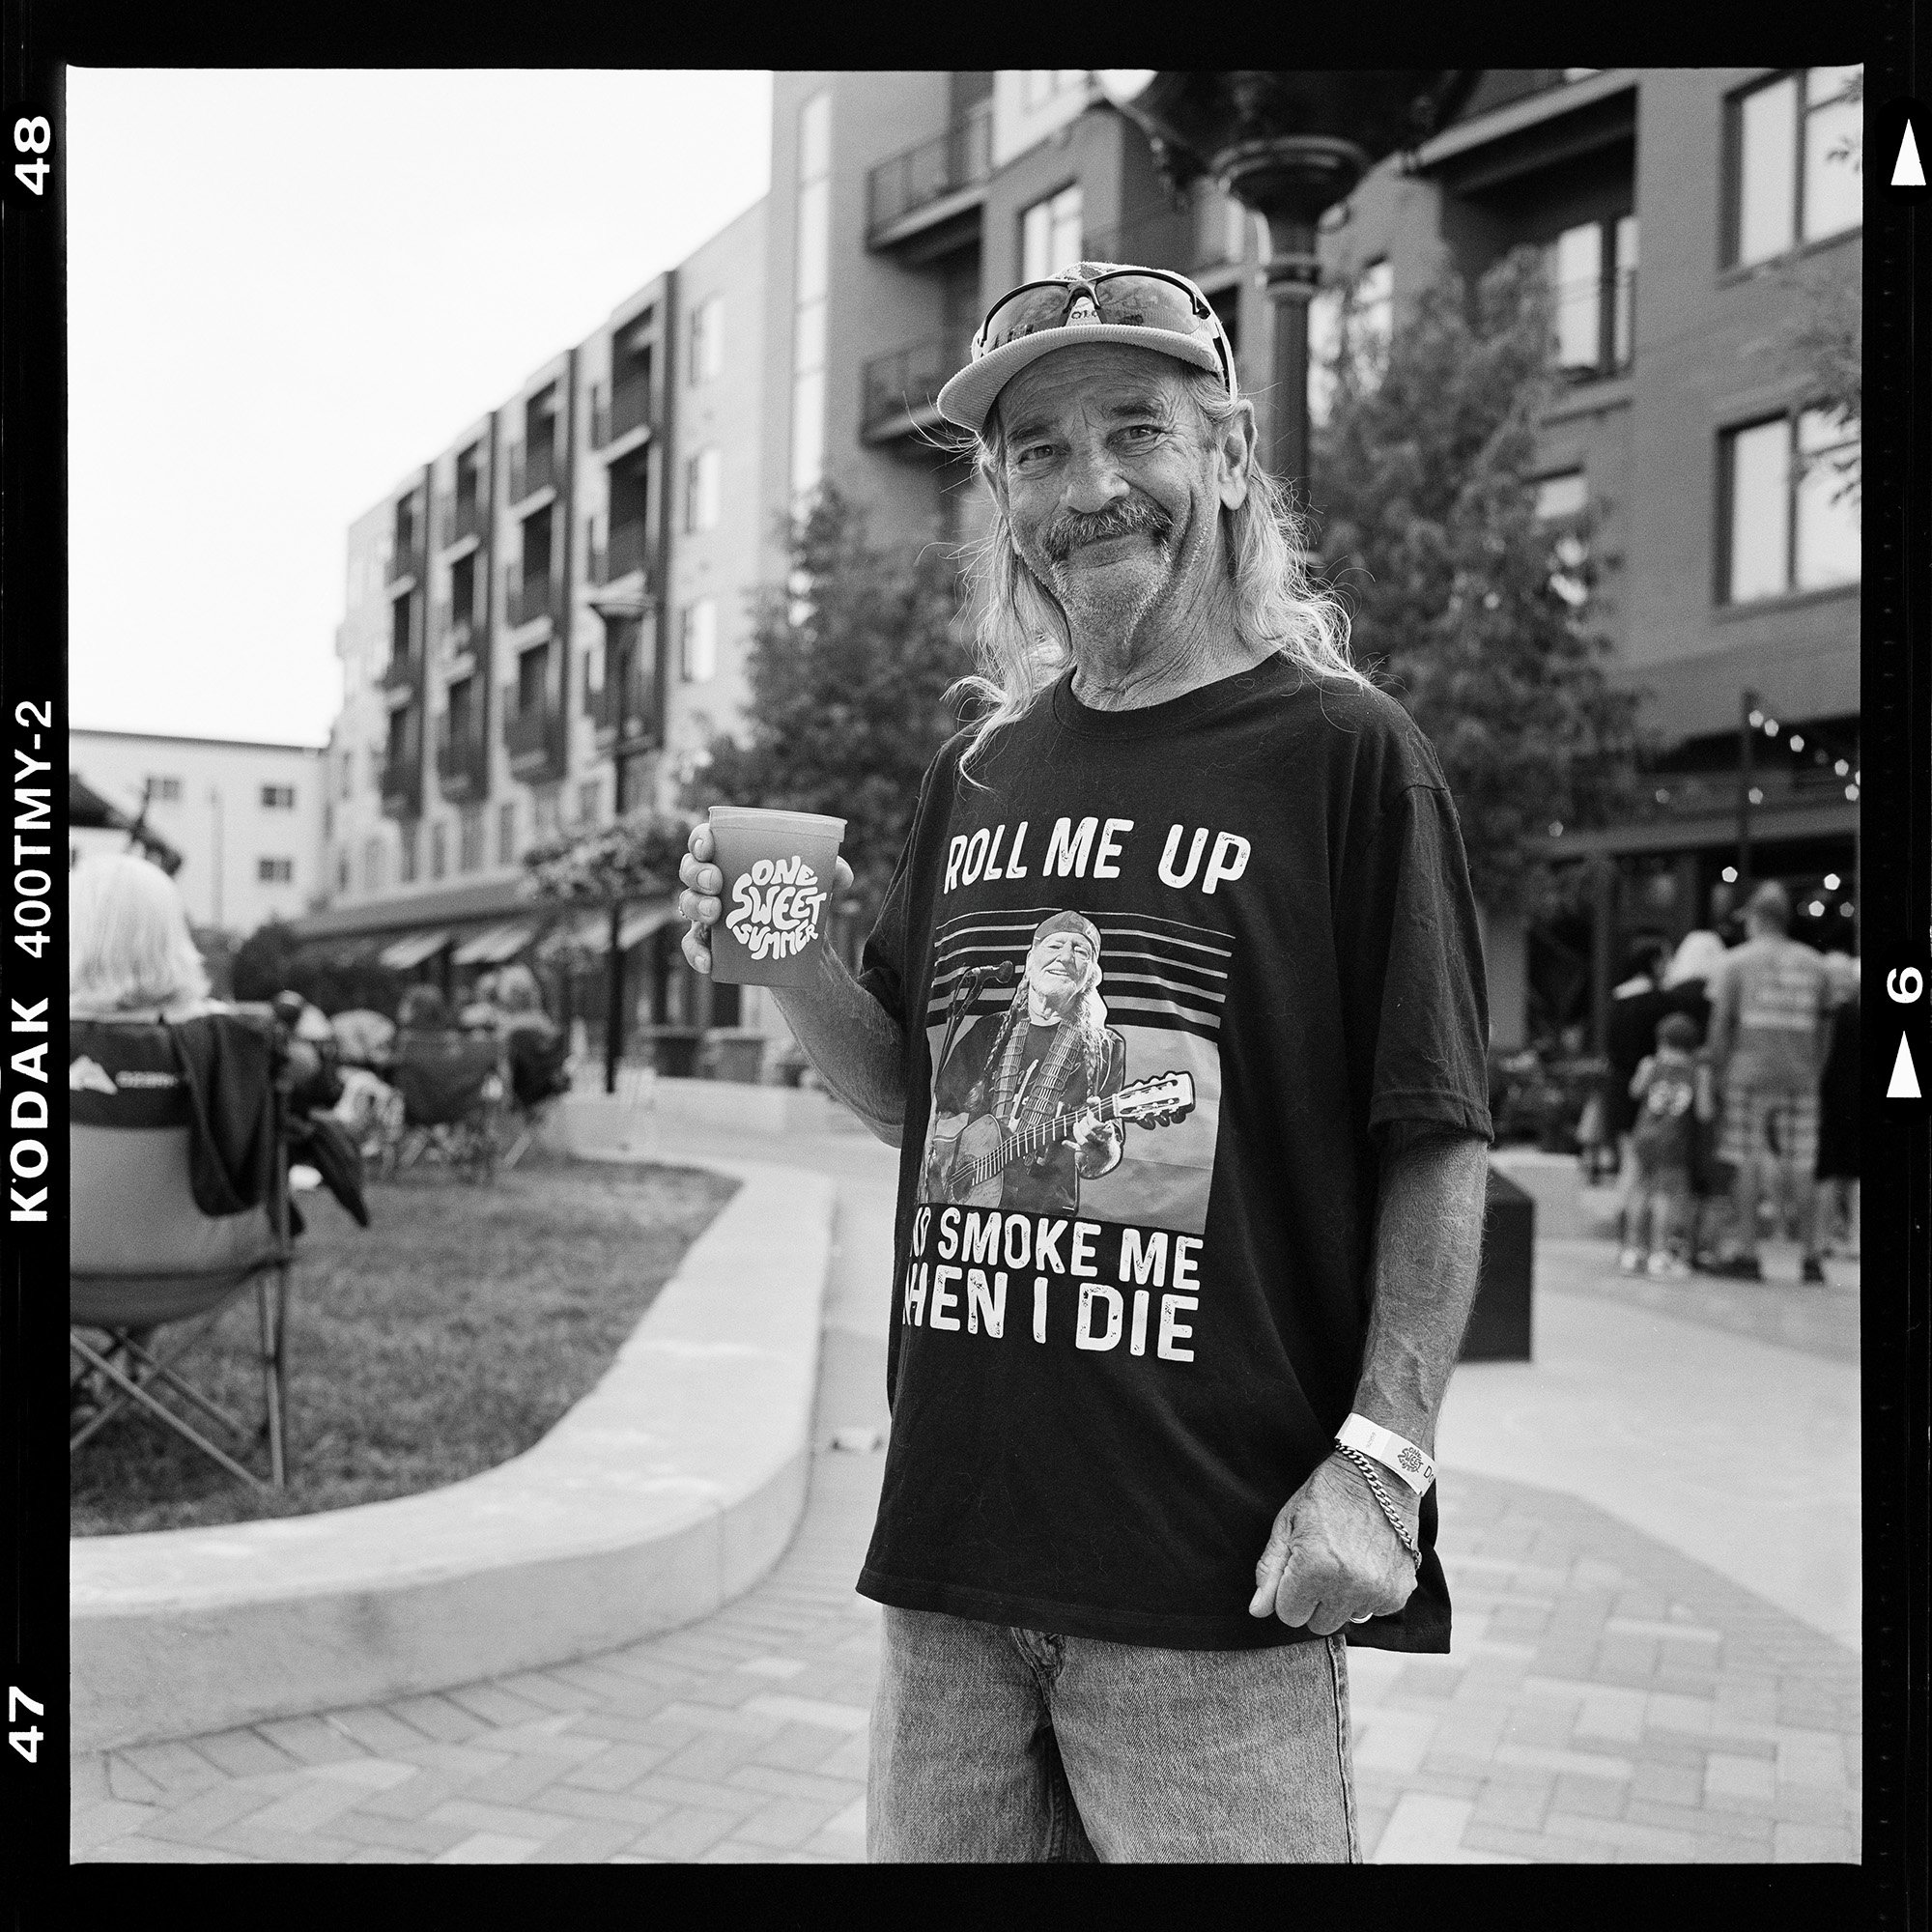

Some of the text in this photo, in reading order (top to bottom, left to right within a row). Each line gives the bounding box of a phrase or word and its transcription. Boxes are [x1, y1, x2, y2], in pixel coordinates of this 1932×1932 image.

[752, 855, 818, 887] ONE
[943, 816, 1252, 895] ROLL ME UP
[725, 872, 827, 930] SWEET
[731, 918, 819, 960] SUMMER
[937, 1207, 1102, 1277] SMOKE
[1119, 1228, 1204, 1291] ME
[1033, 1276, 1049, 1344] I
[1075, 1282, 1200, 1363] DIE
